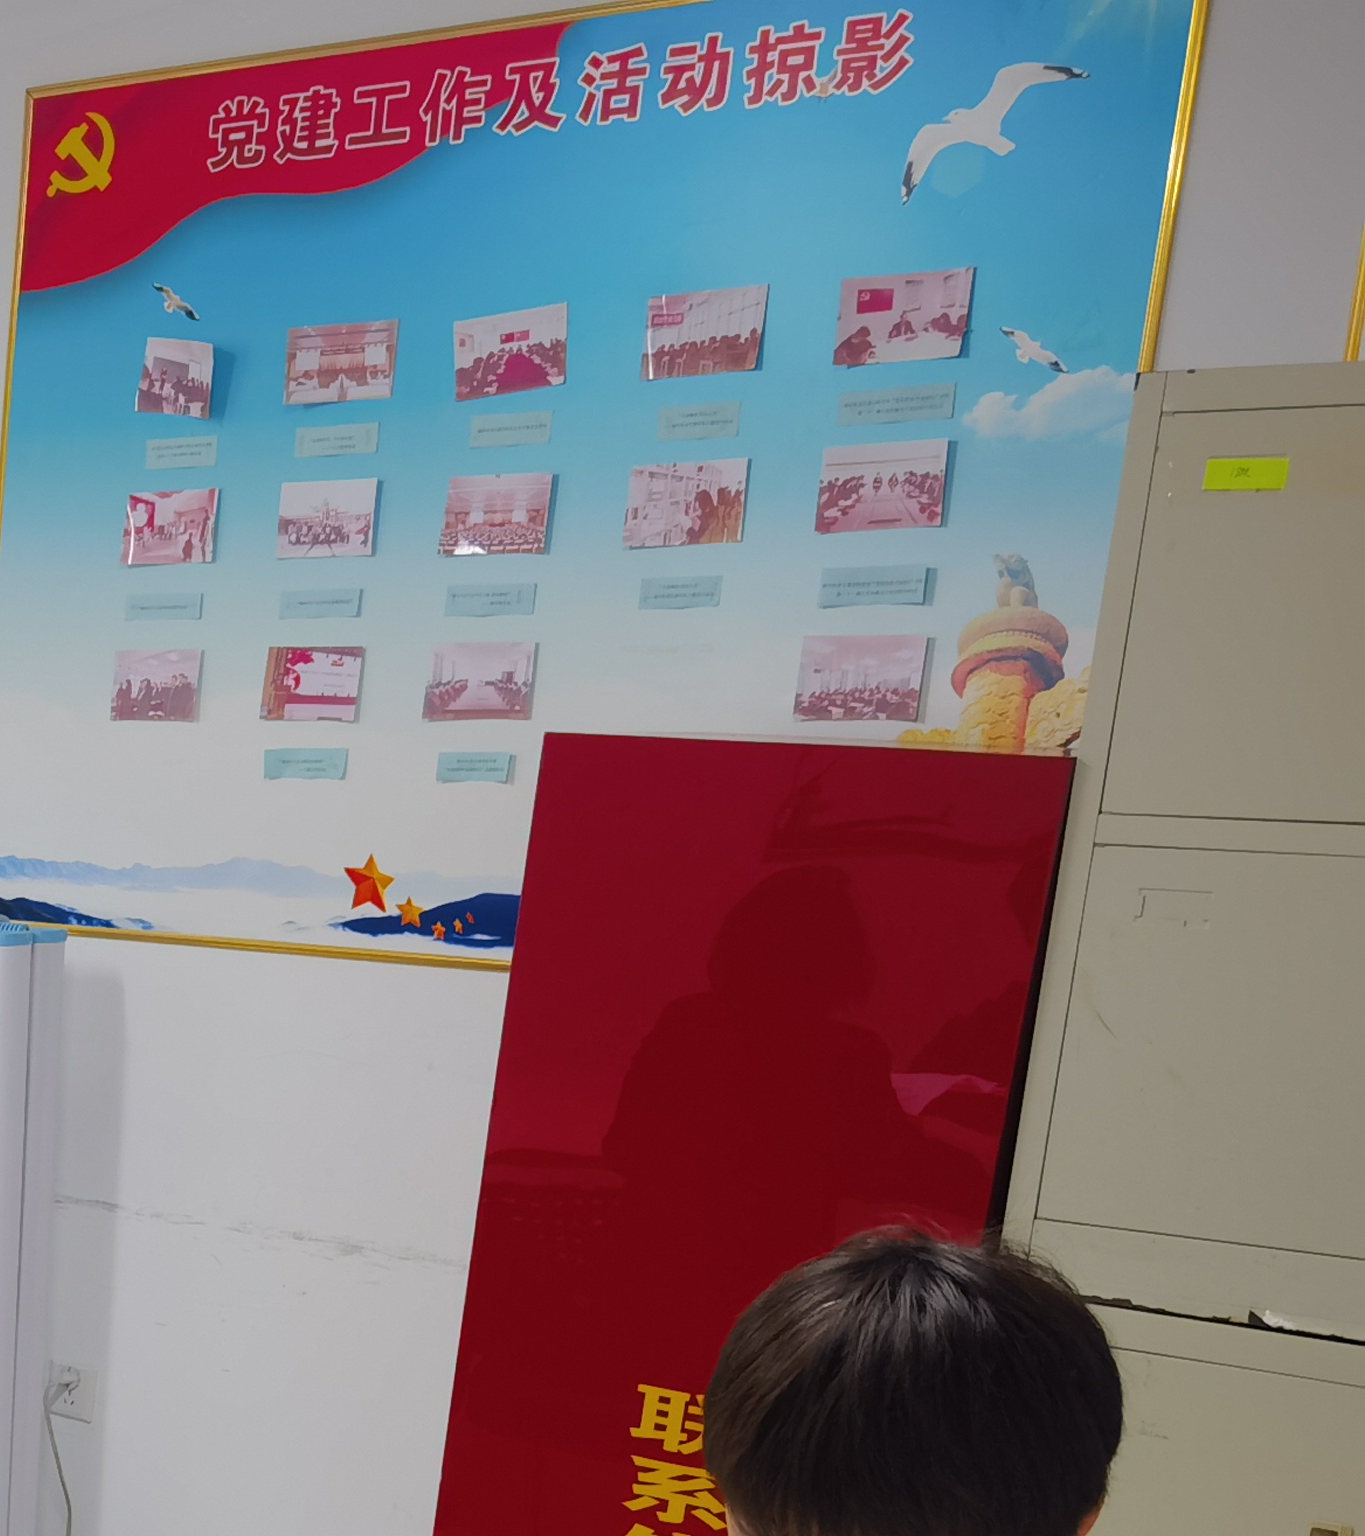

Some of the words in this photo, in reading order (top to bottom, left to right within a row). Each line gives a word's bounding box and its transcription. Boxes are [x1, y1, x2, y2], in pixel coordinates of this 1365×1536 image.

[205, 9, 917, 175] 党建工作及活动掠影
